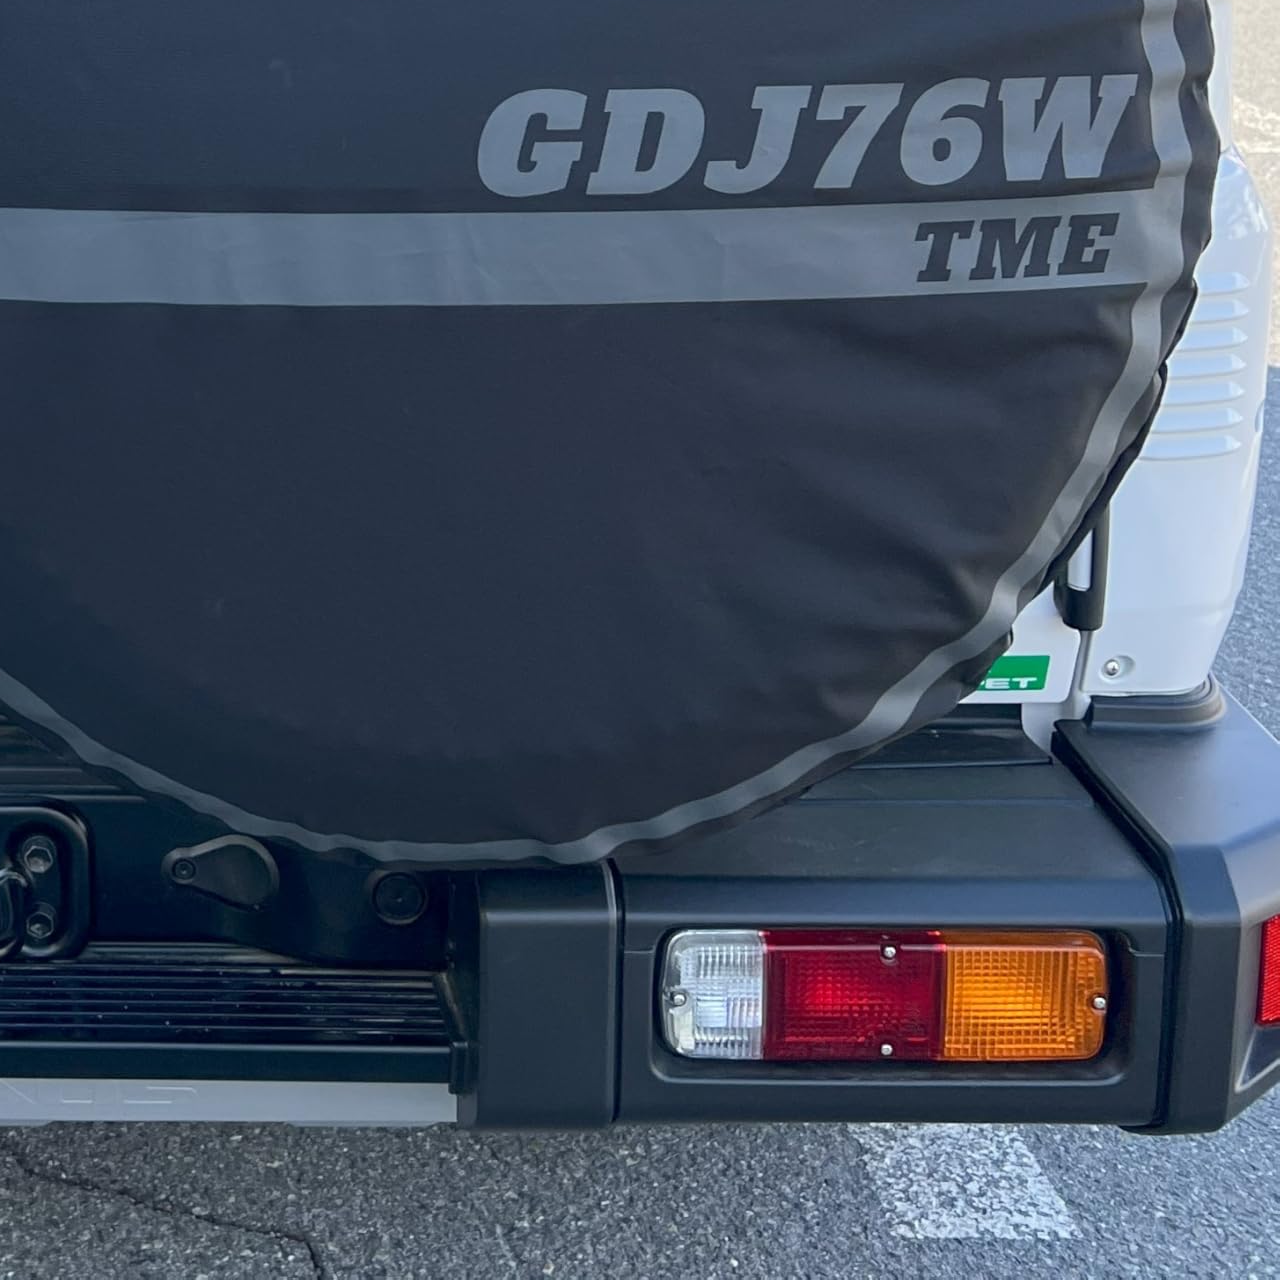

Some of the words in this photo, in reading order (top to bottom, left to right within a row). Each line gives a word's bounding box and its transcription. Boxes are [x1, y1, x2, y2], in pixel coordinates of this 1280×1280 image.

[477, 73, 1138, 197] GDJ76W
[914, 212, 1119, 282] TME
[980, 677, 1038, 689] ET
